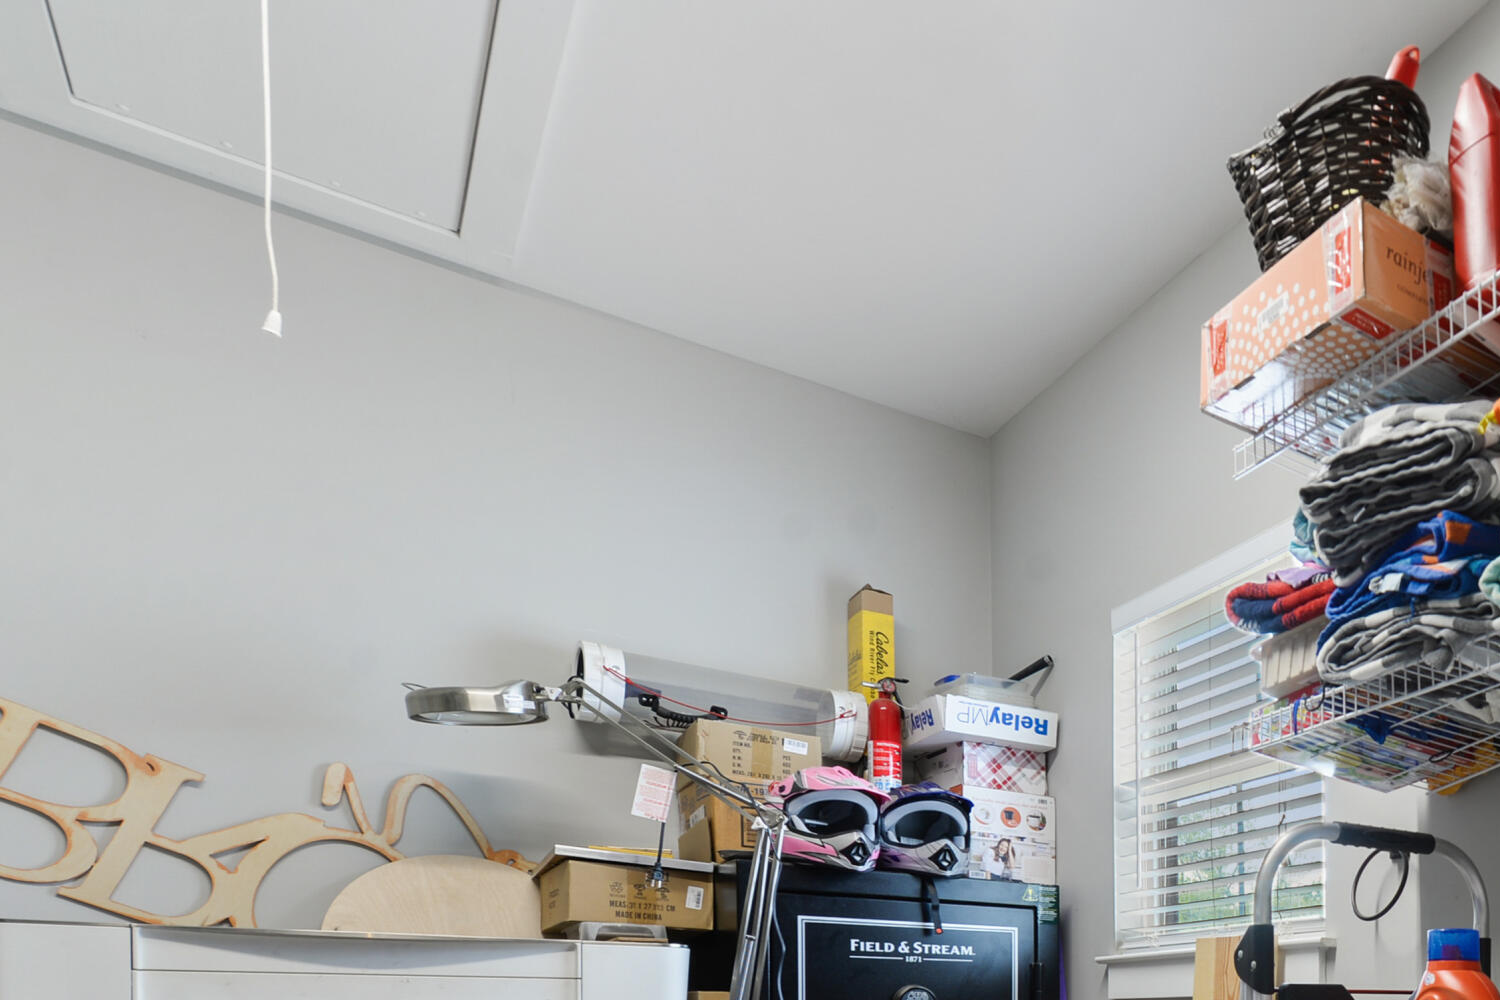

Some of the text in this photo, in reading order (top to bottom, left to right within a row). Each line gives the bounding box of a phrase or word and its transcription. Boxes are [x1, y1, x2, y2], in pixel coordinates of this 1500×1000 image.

[910, 708, 935, 735] Relay
[615, 910, 663, 921] MADE IN CHINA
[850, 939, 895, 953] FIELD
[898, 941, 910, 954] &
[905, 955, 922, 963] 1871
